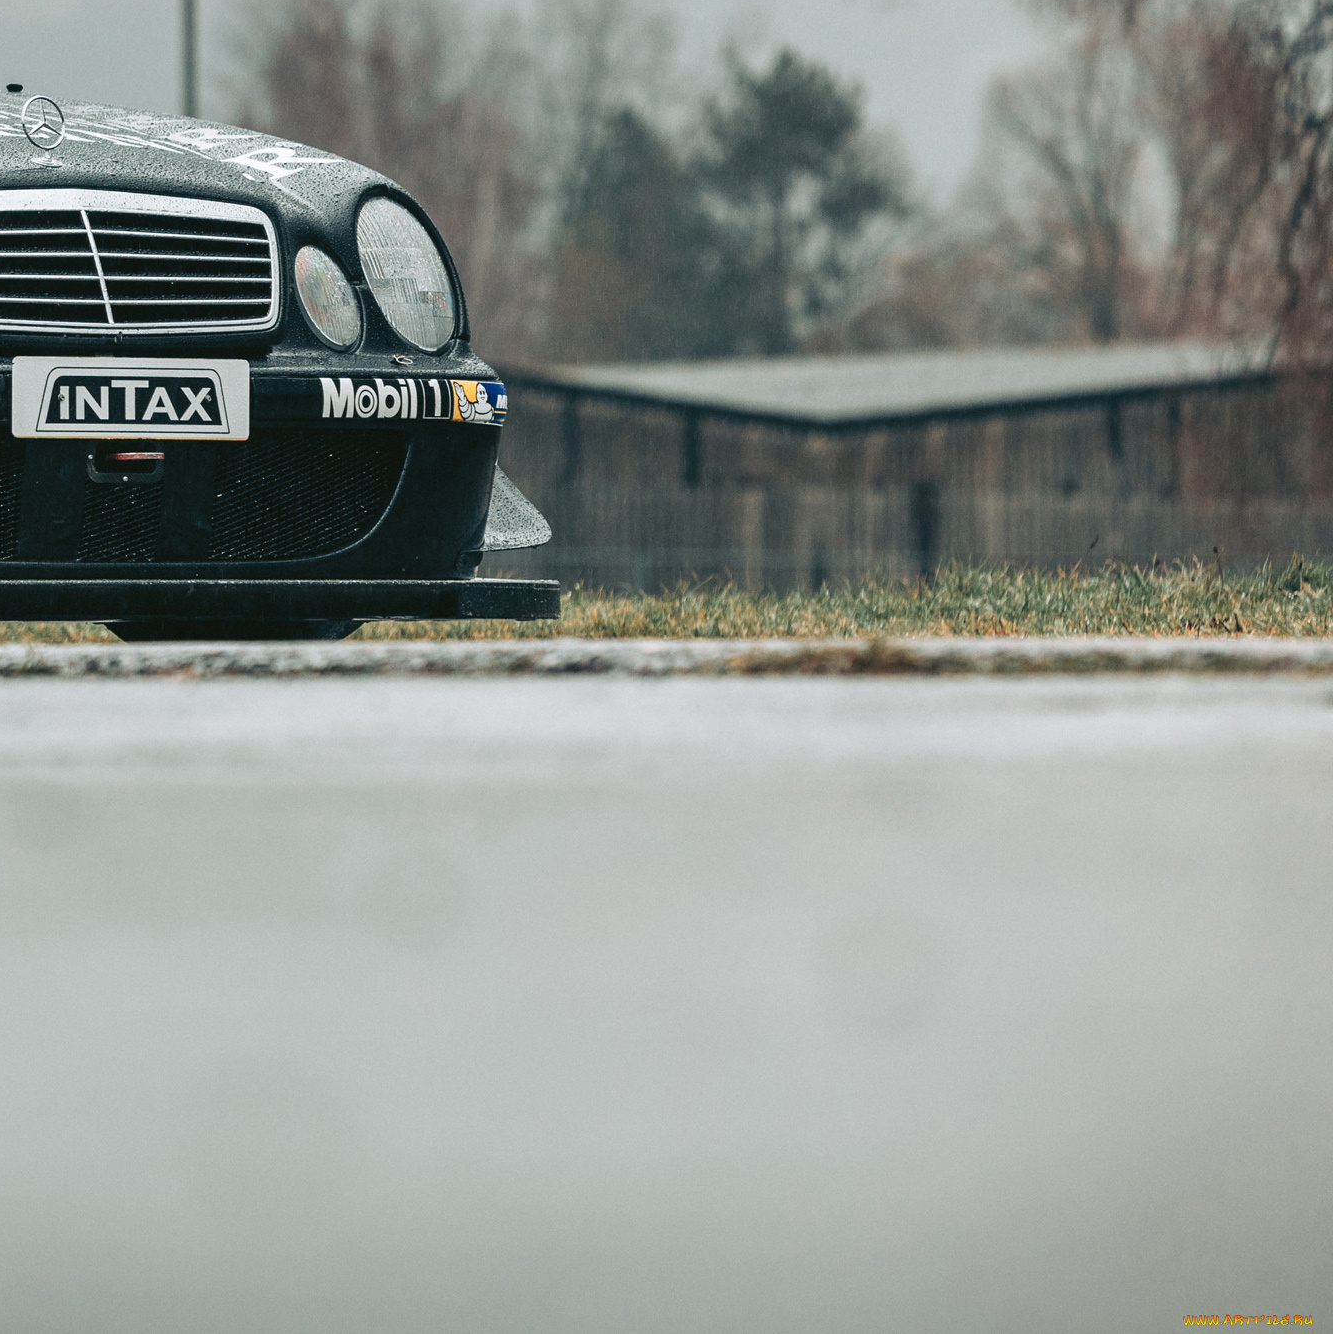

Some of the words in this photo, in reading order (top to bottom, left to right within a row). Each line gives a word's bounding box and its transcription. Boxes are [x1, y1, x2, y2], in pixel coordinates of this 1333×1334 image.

[58, 379, 213, 421] INTAX
[321, 377, 418, 420] Mobil
[428, 378, 442, 417] 1
